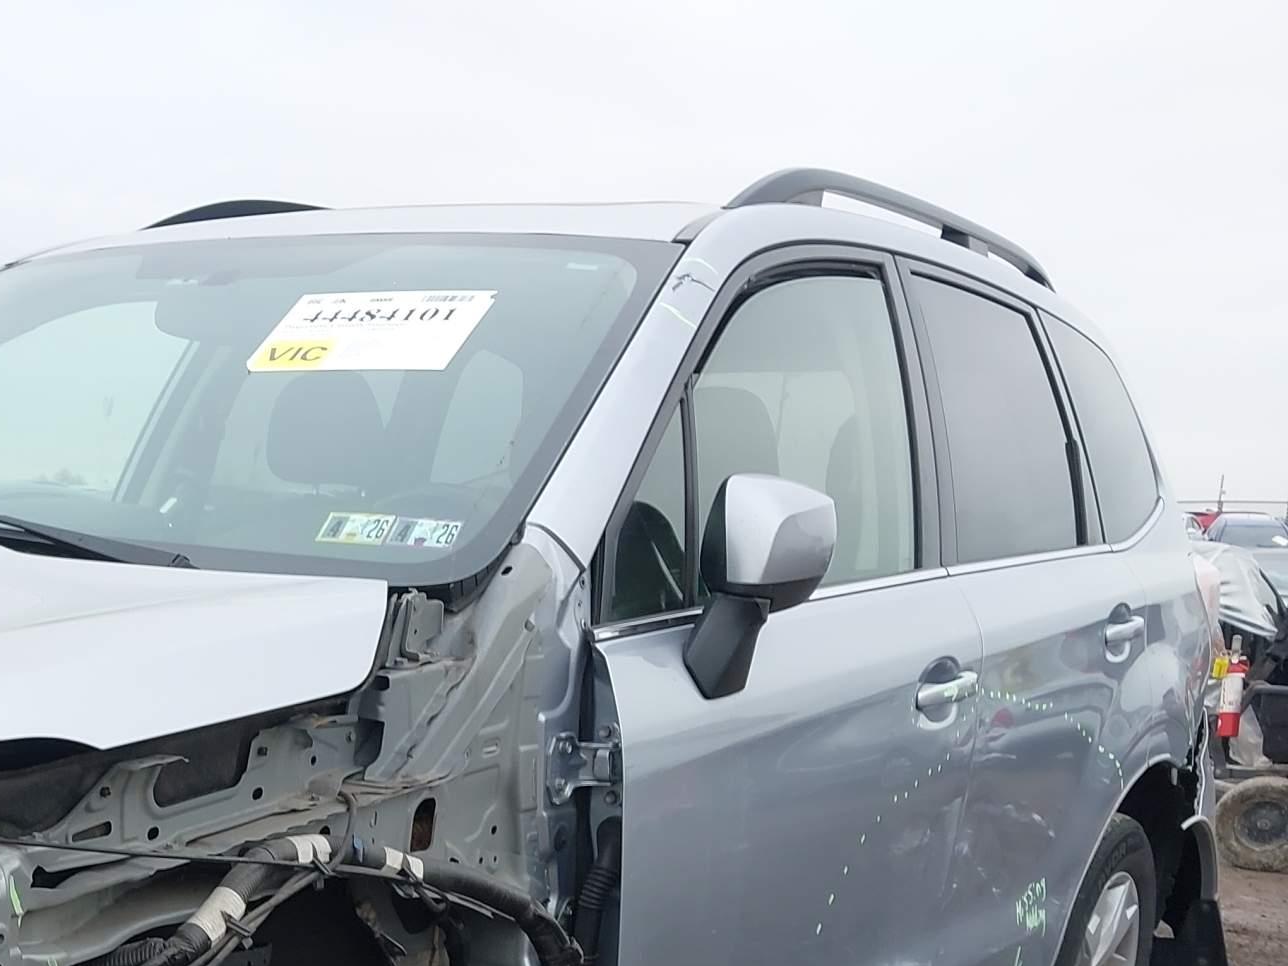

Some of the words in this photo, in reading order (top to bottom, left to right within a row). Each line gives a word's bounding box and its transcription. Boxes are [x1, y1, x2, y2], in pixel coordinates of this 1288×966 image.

[303, 307, 457, 323] 44484101
[268, 345, 329, 362] VIC
[327, 519, 344, 538] 4
[366, 518, 391, 540] 26
[396, 523, 413, 543] 4
[435, 523, 459, 545] 26
